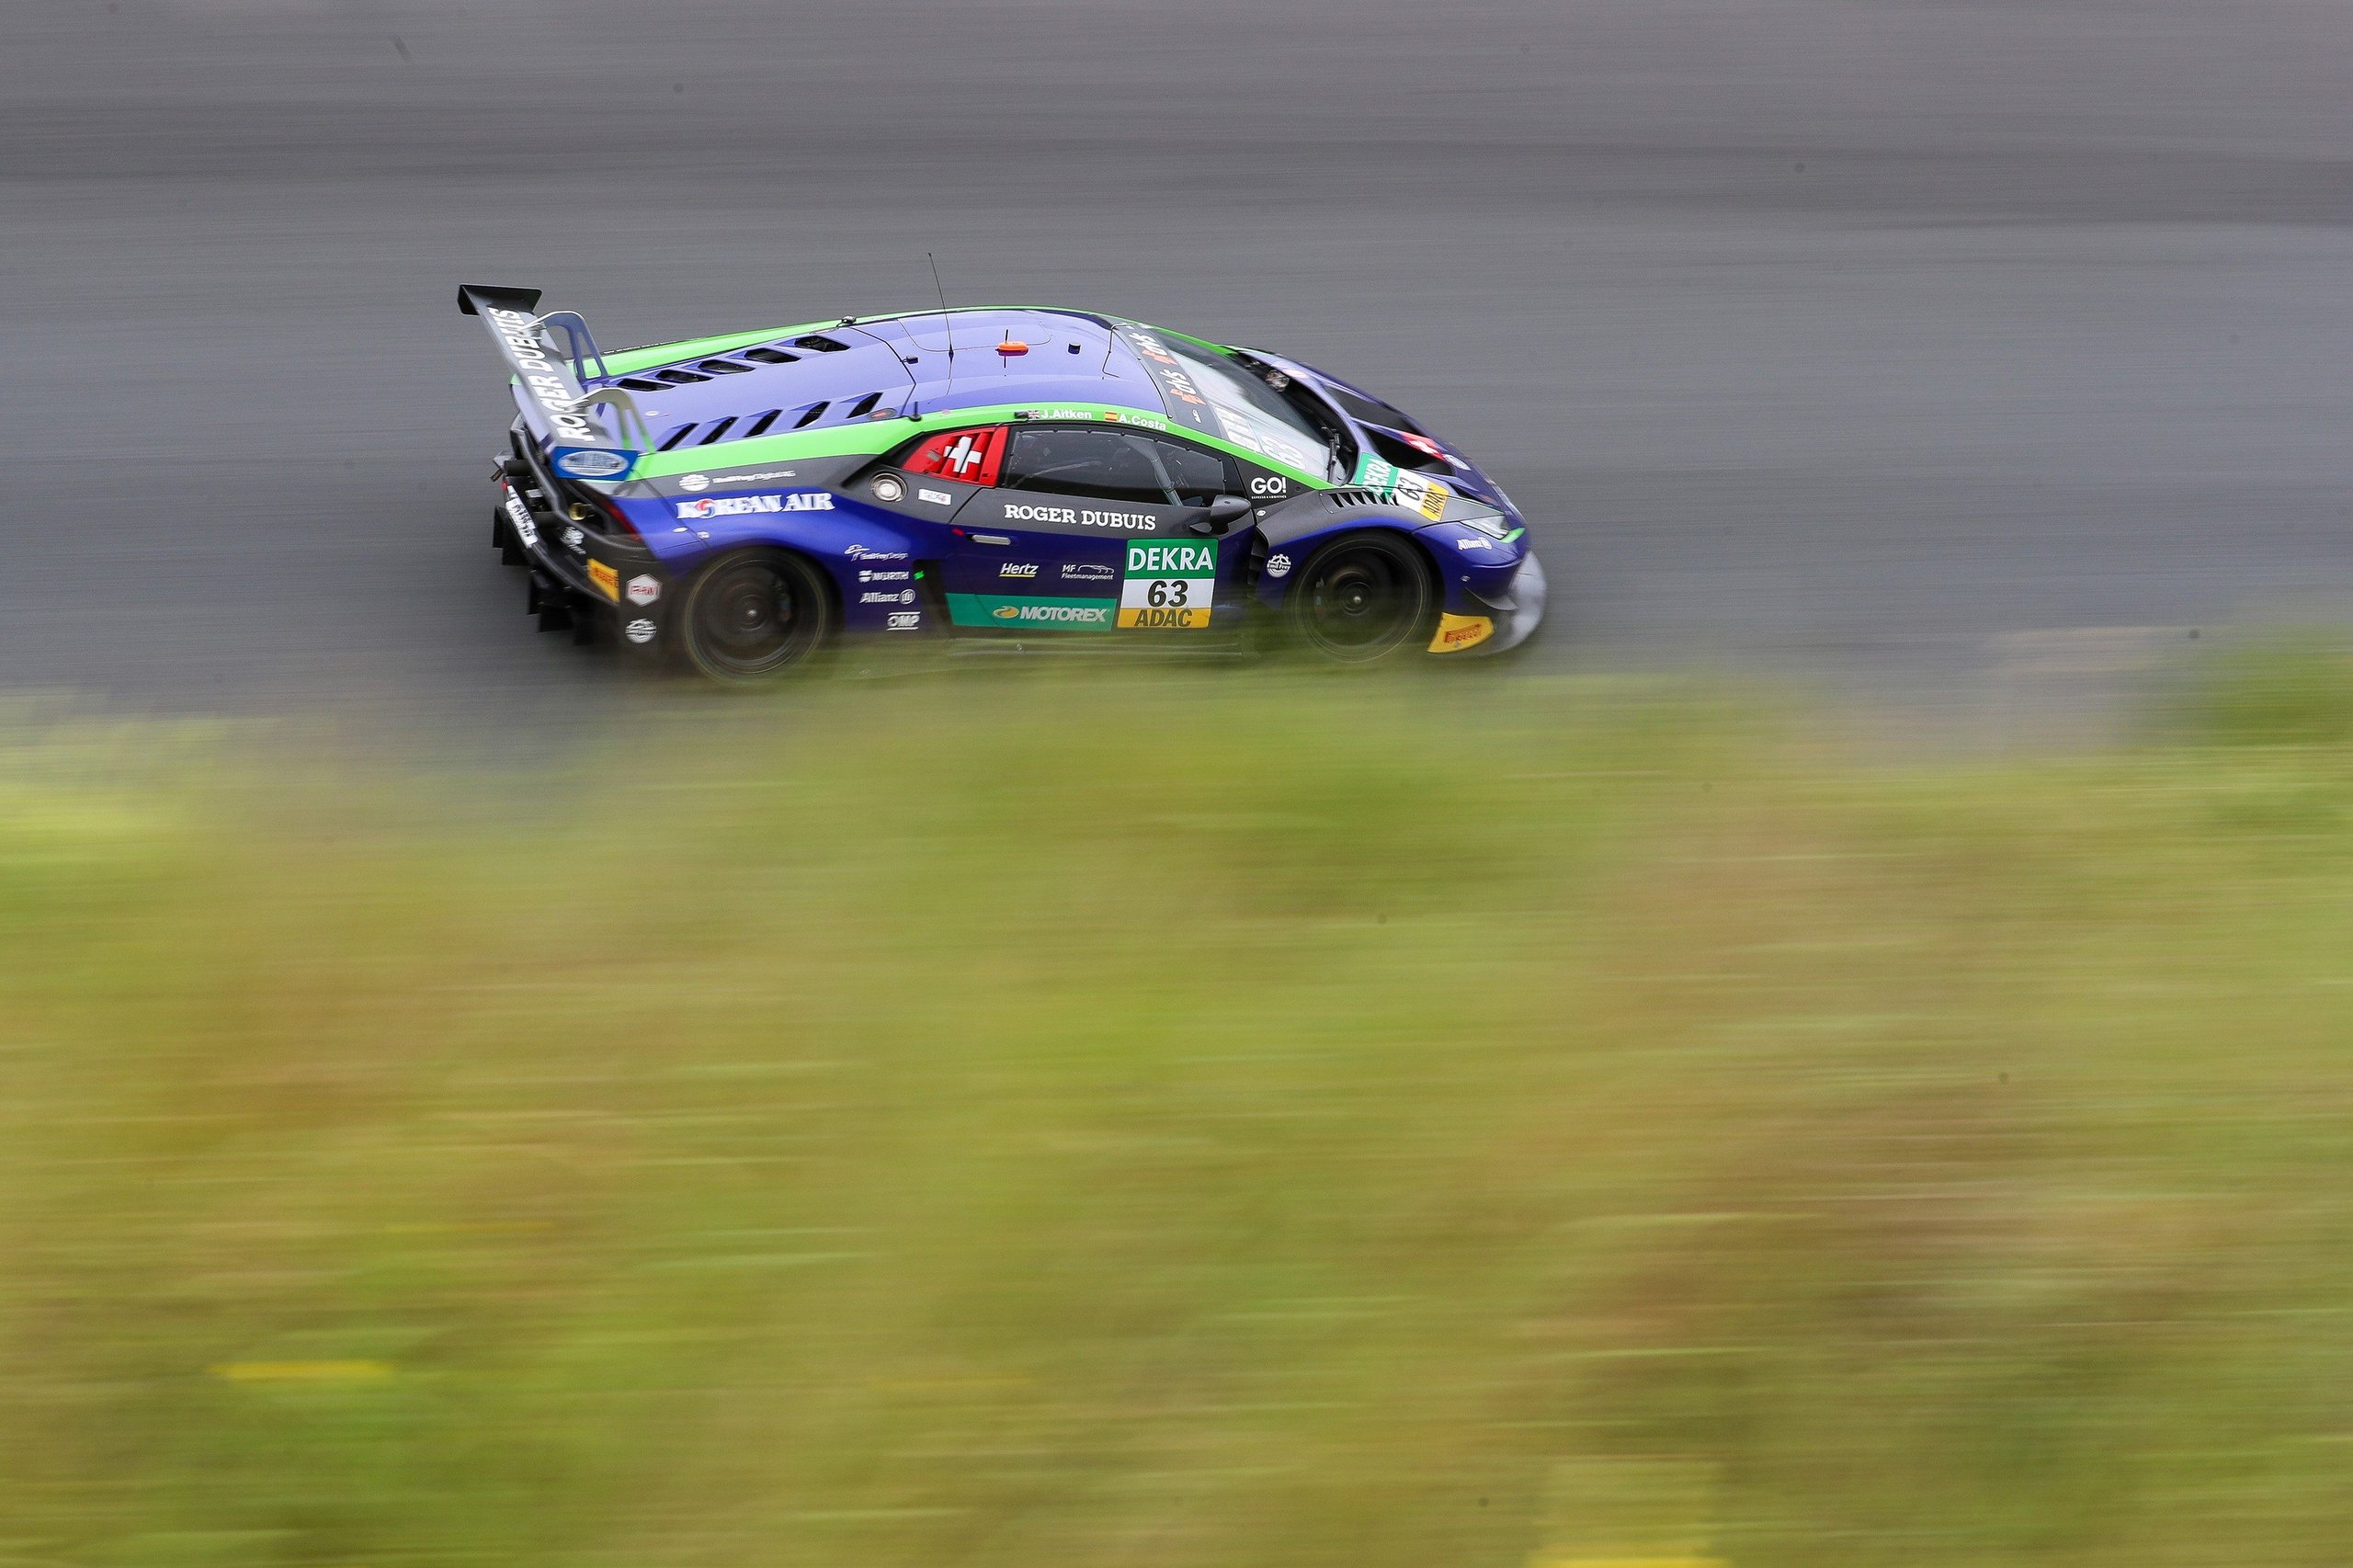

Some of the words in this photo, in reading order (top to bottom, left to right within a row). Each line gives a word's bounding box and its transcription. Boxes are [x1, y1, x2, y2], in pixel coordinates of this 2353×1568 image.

[1040, 409, 1092, 420] J.Aitken
[1117, 414, 1166, 430] A.Costa
[1251, 477, 1287, 494] GO!
[1398, 477, 1423, 501] 63
[676, 494, 781, 518] KOREAN
[781, 493, 835, 512] AIR
[1423, 487, 1445, 518] ADAC
[1004, 505, 1076, 524] ROGER
[1081, 510, 1156, 531] DUBUIS
[1129, 547, 1213, 571] DEKRA
[1001, 563, 1039, 575] Hertz
[1061, 573, 1113, 581] Fleetmanagement
[859, 592, 900, 604] Allianz
[1147, 580, 1188, 608] 63
[887, 615, 920, 628] OMP
[1020, 606, 1108, 623] MOTOREX
[1134, 608, 1193, 628] ADAC
